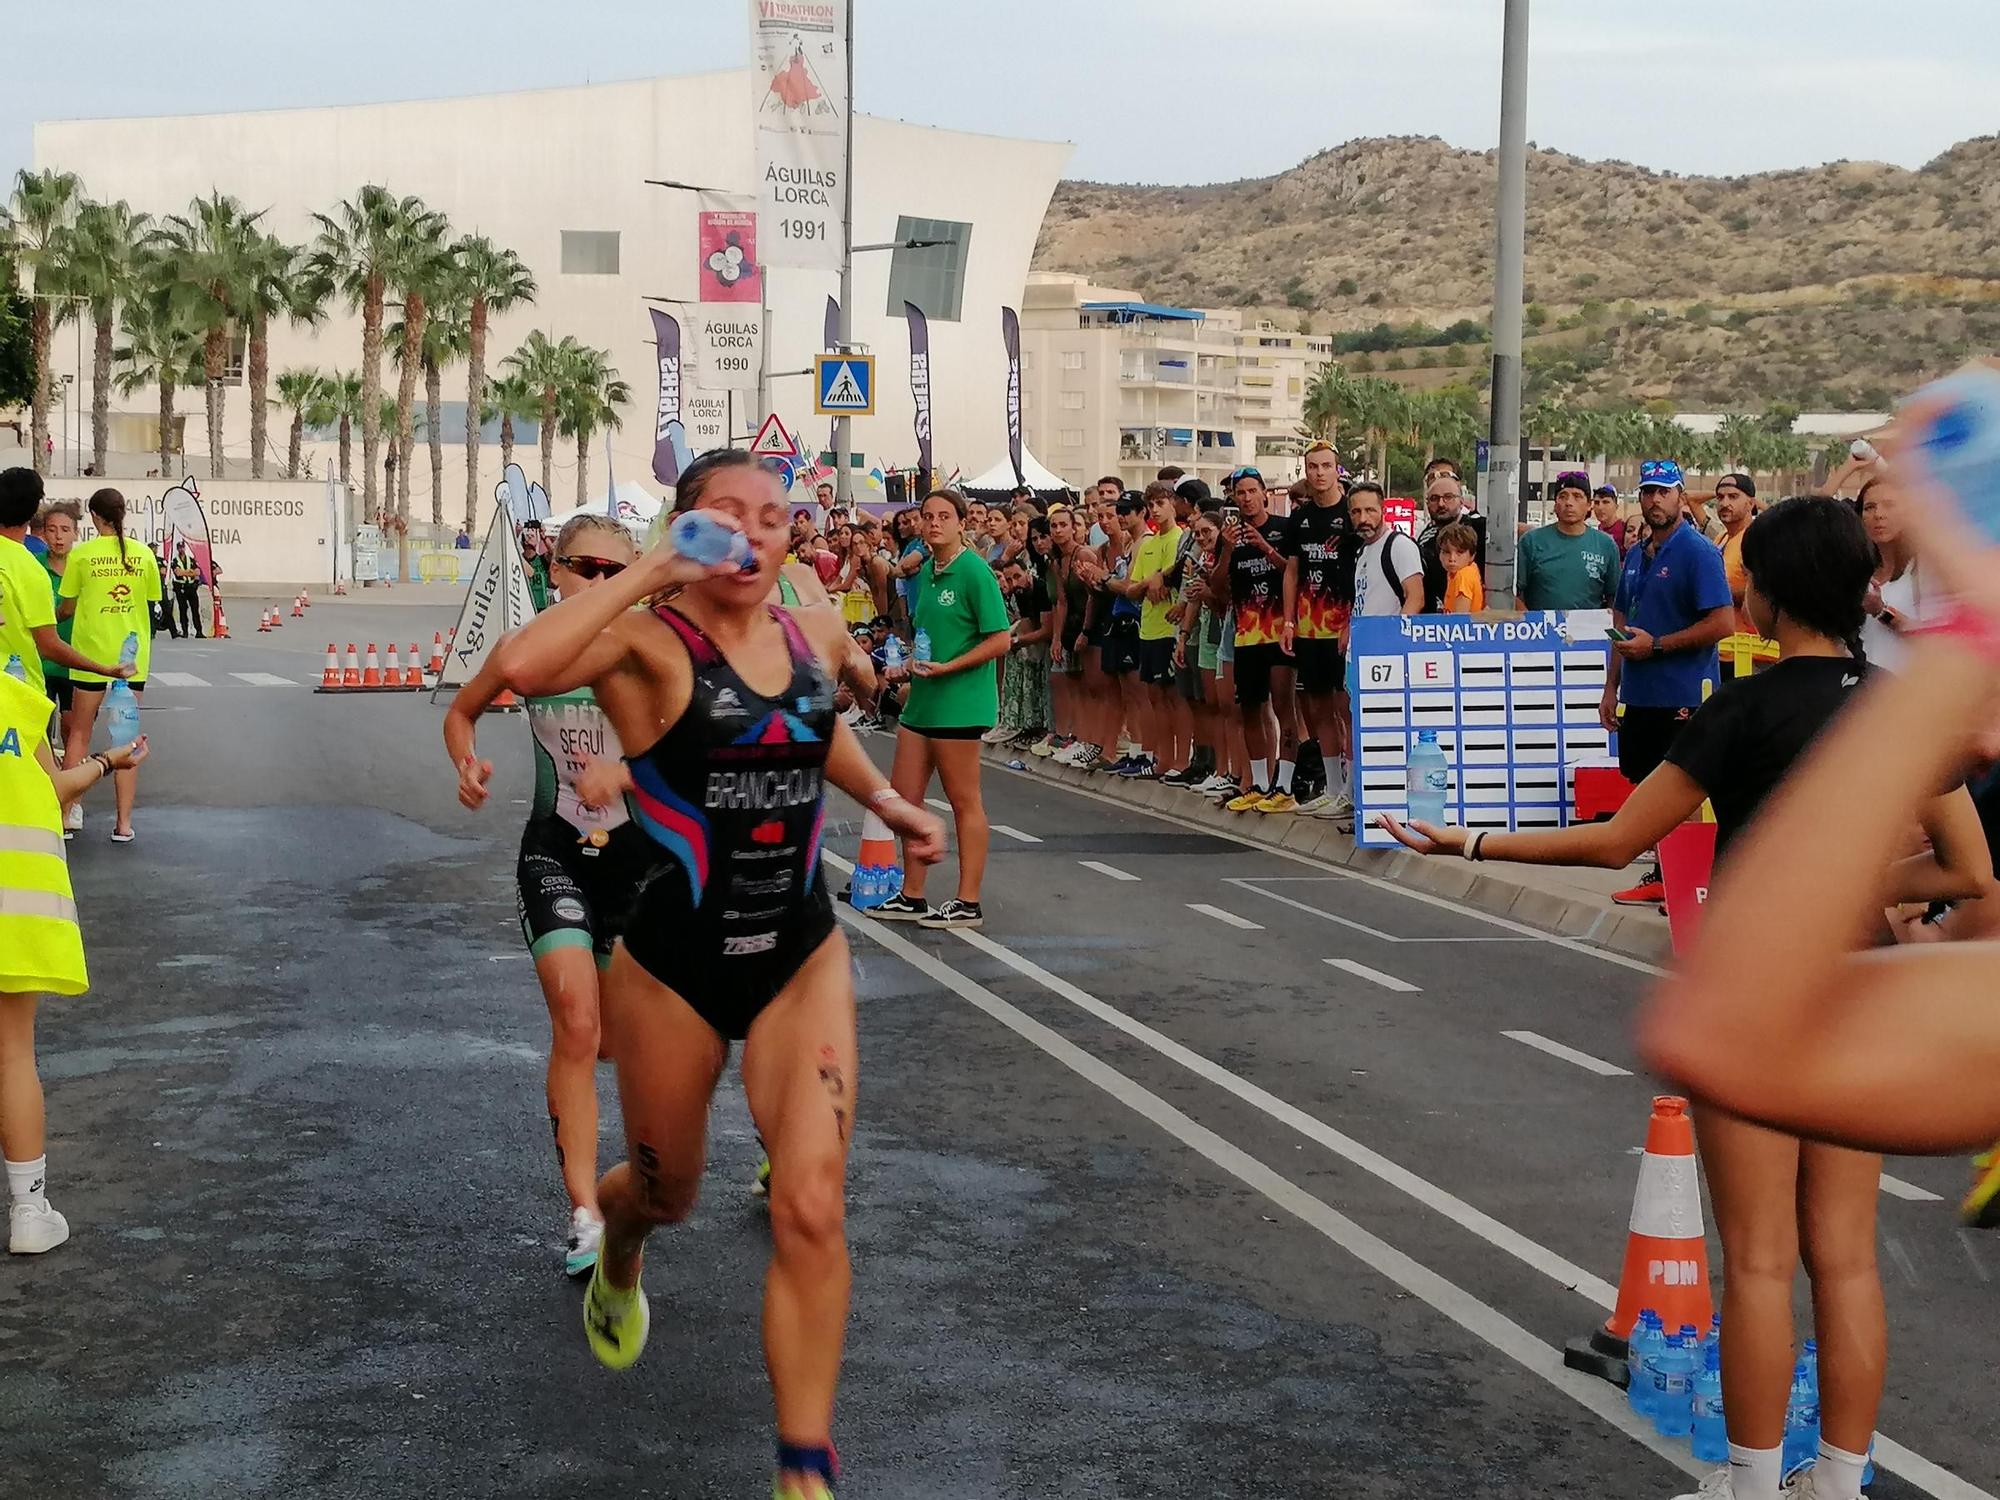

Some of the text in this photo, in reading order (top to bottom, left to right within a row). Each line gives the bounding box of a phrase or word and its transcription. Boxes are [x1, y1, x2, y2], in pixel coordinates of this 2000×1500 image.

[776, 3, 833, 17] TRIATHLON
[765, 161, 836, 187] ÁGUILAS
[774, 186, 829, 207] LORCA
[780, 219, 825, 240] 1991
[705, 321, 758, 334] ÁGUILAS
[711, 336, 753, 348] LORCA
[715, 357, 749, 371] 1990
[692, 409, 723, 418] LORCA
[696, 424, 720, 435] 1987
[211, 499, 304, 516] CONGRESOS
[90, 556, 142, 566] SWIM XIT
[509, 562, 521, 627] uilas
[456, 562, 500, 668] Águilas
[1411, 622, 1498, 643] PENALTY
[1503, 621, 1545, 641] BOX
[1371, 665, 1392, 682] 67
[1425, 661, 1438, 679] E
[560, 722, 605, 756] SEGUÍ
